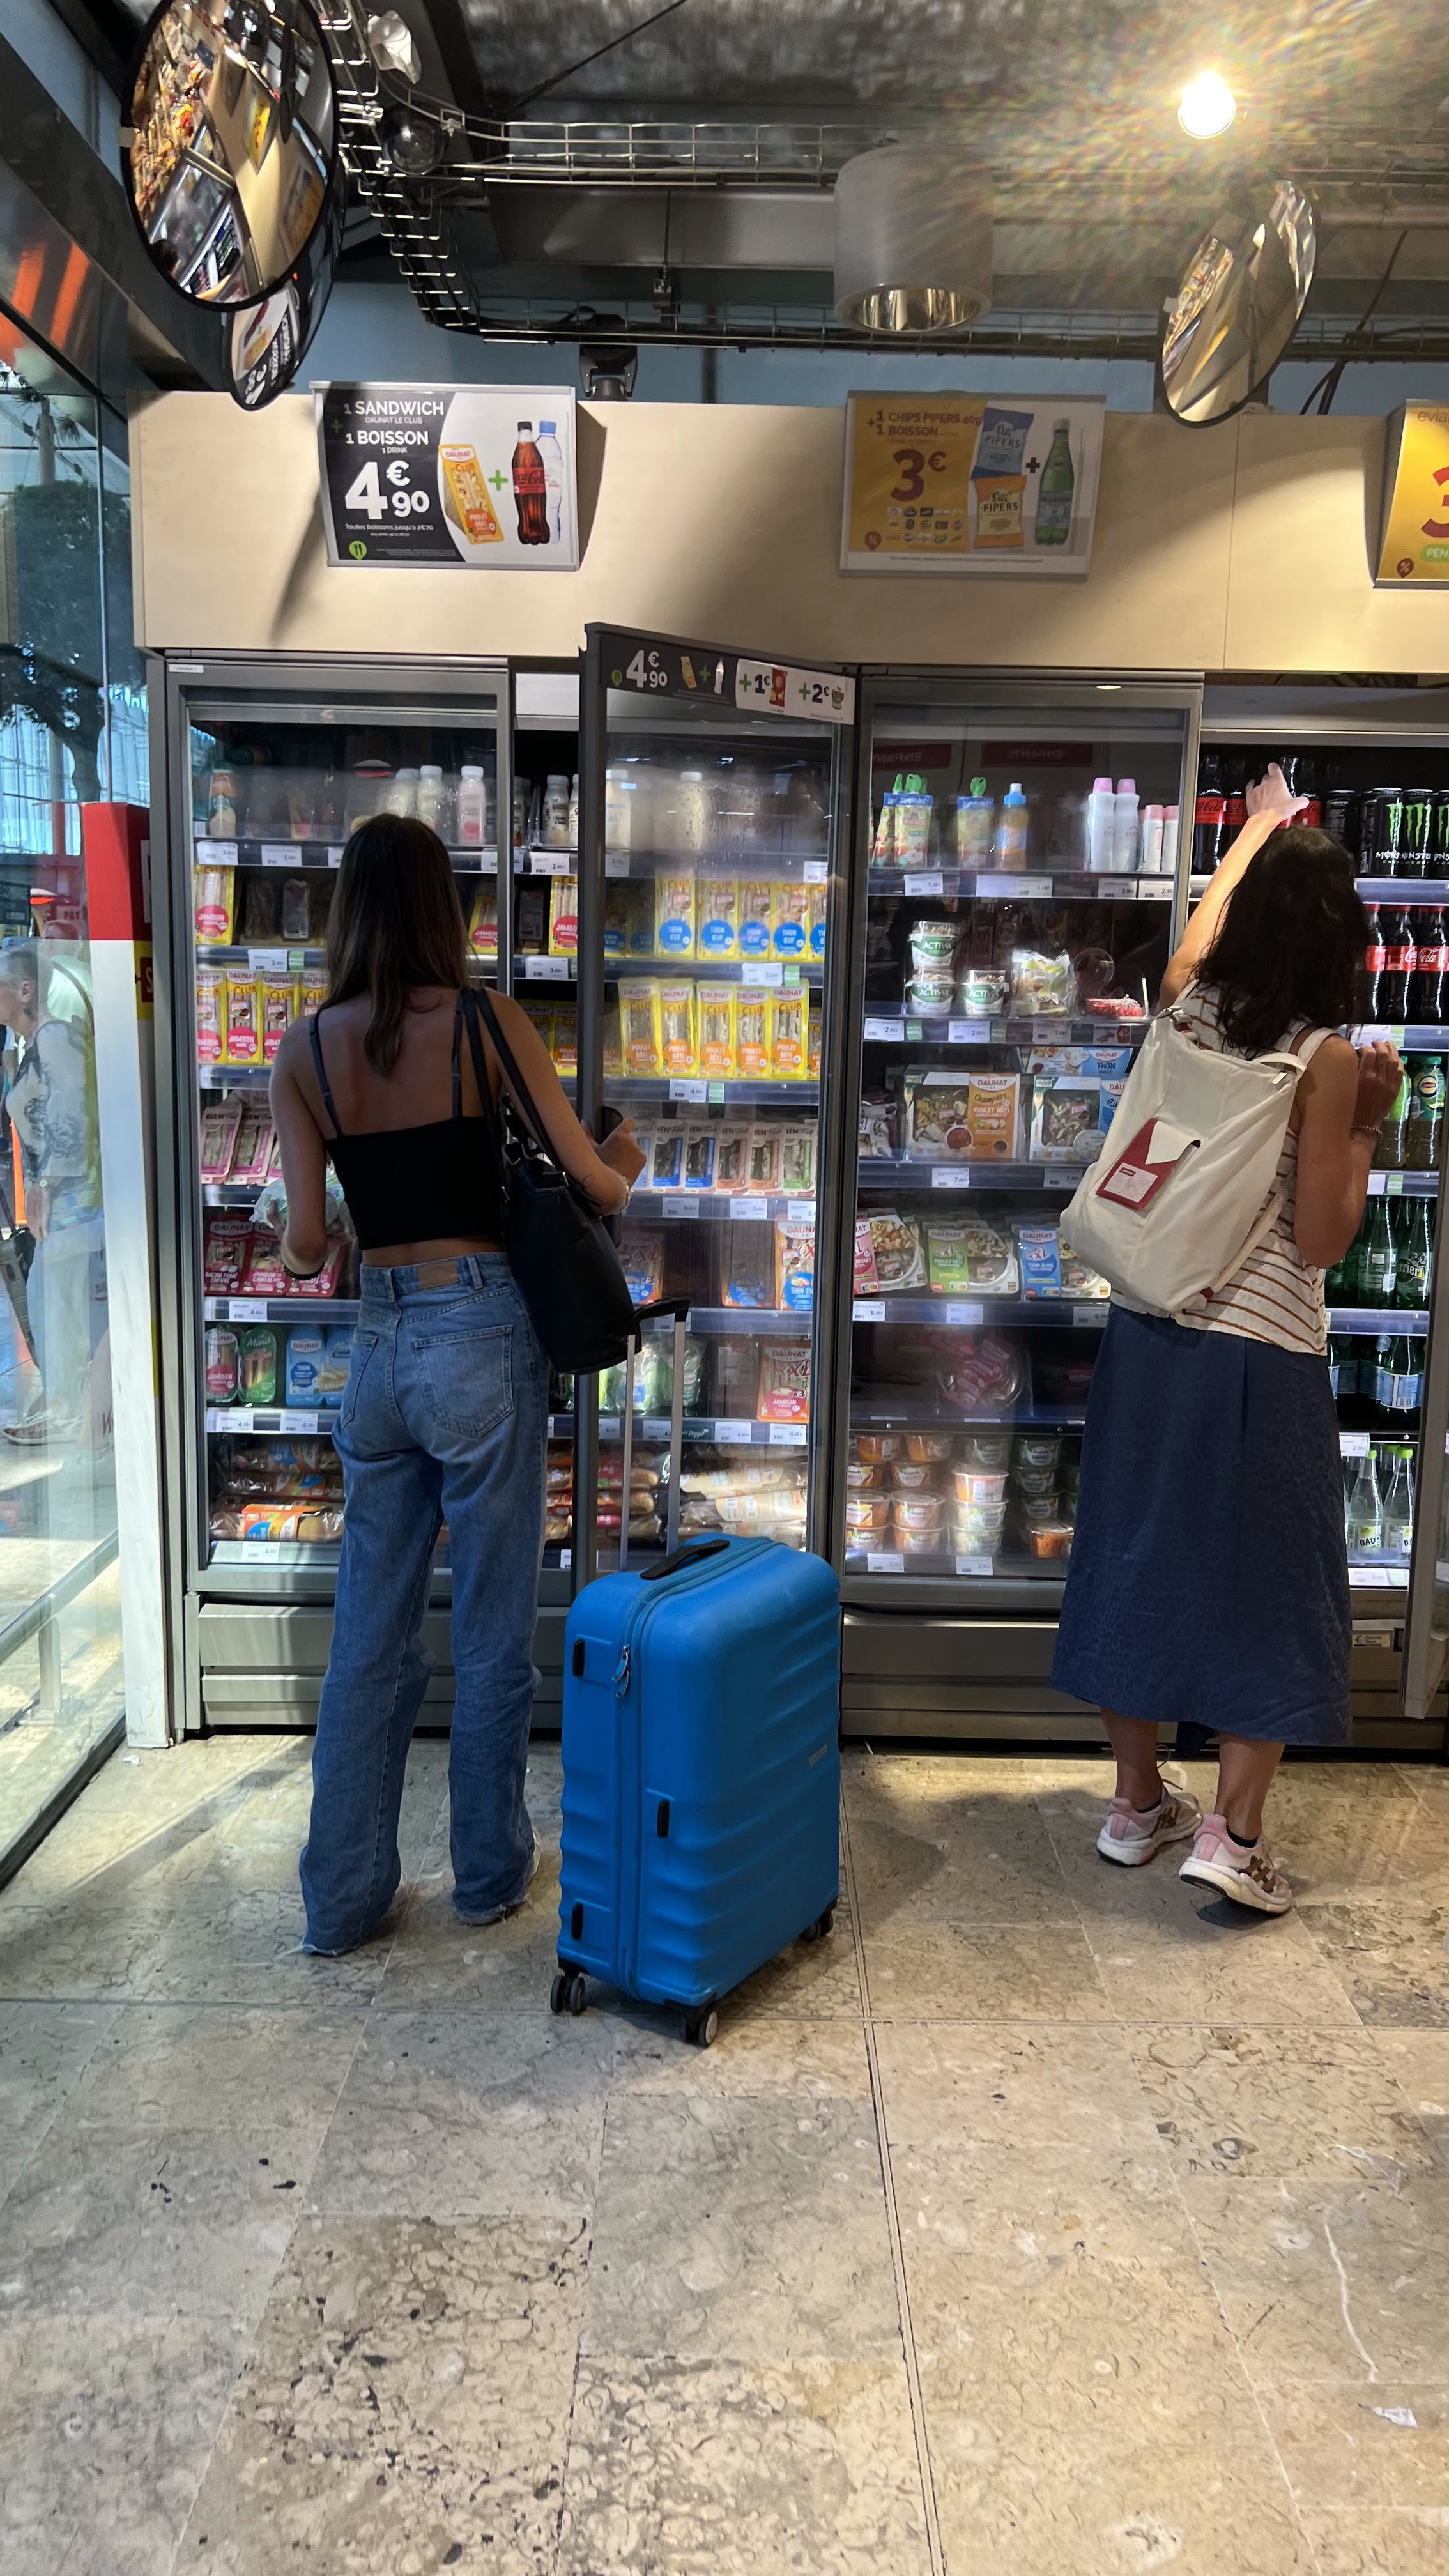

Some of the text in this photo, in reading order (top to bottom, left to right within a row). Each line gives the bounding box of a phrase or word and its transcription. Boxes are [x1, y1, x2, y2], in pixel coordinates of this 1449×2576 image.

[344, 401, 445, 416] 1 SANDWICH
[876, 410, 983, 426] 1 CHIPS PIPERS 40g
[1418, 411, 1449, 423] evia
[875, 424, 938, 436] 1 BOISSON
[346, 430, 429, 445] 1 BOISSON
[985, 434, 1020, 448] PIPERS
[983, 502, 1018, 512] PIPERS
[1426, 548, 1449, 558] PEN
[923, 941, 951, 950] ACTIVIA
[233, 986, 256, 995] CLUB
[270, 991, 293, 999] CLUB
[969, 990, 999, 999] ACTIVIA
[631, 1002, 653, 1011] CLUB
[667, 1004, 688, 1013] CLUB
[707, 1005, 730, 1014] CLUB
[742, 1006, 765, 1015] CLUB
[779, 1002, 802, 1011] CLUB
[1399, 1261, 1420, 1276] rrier
